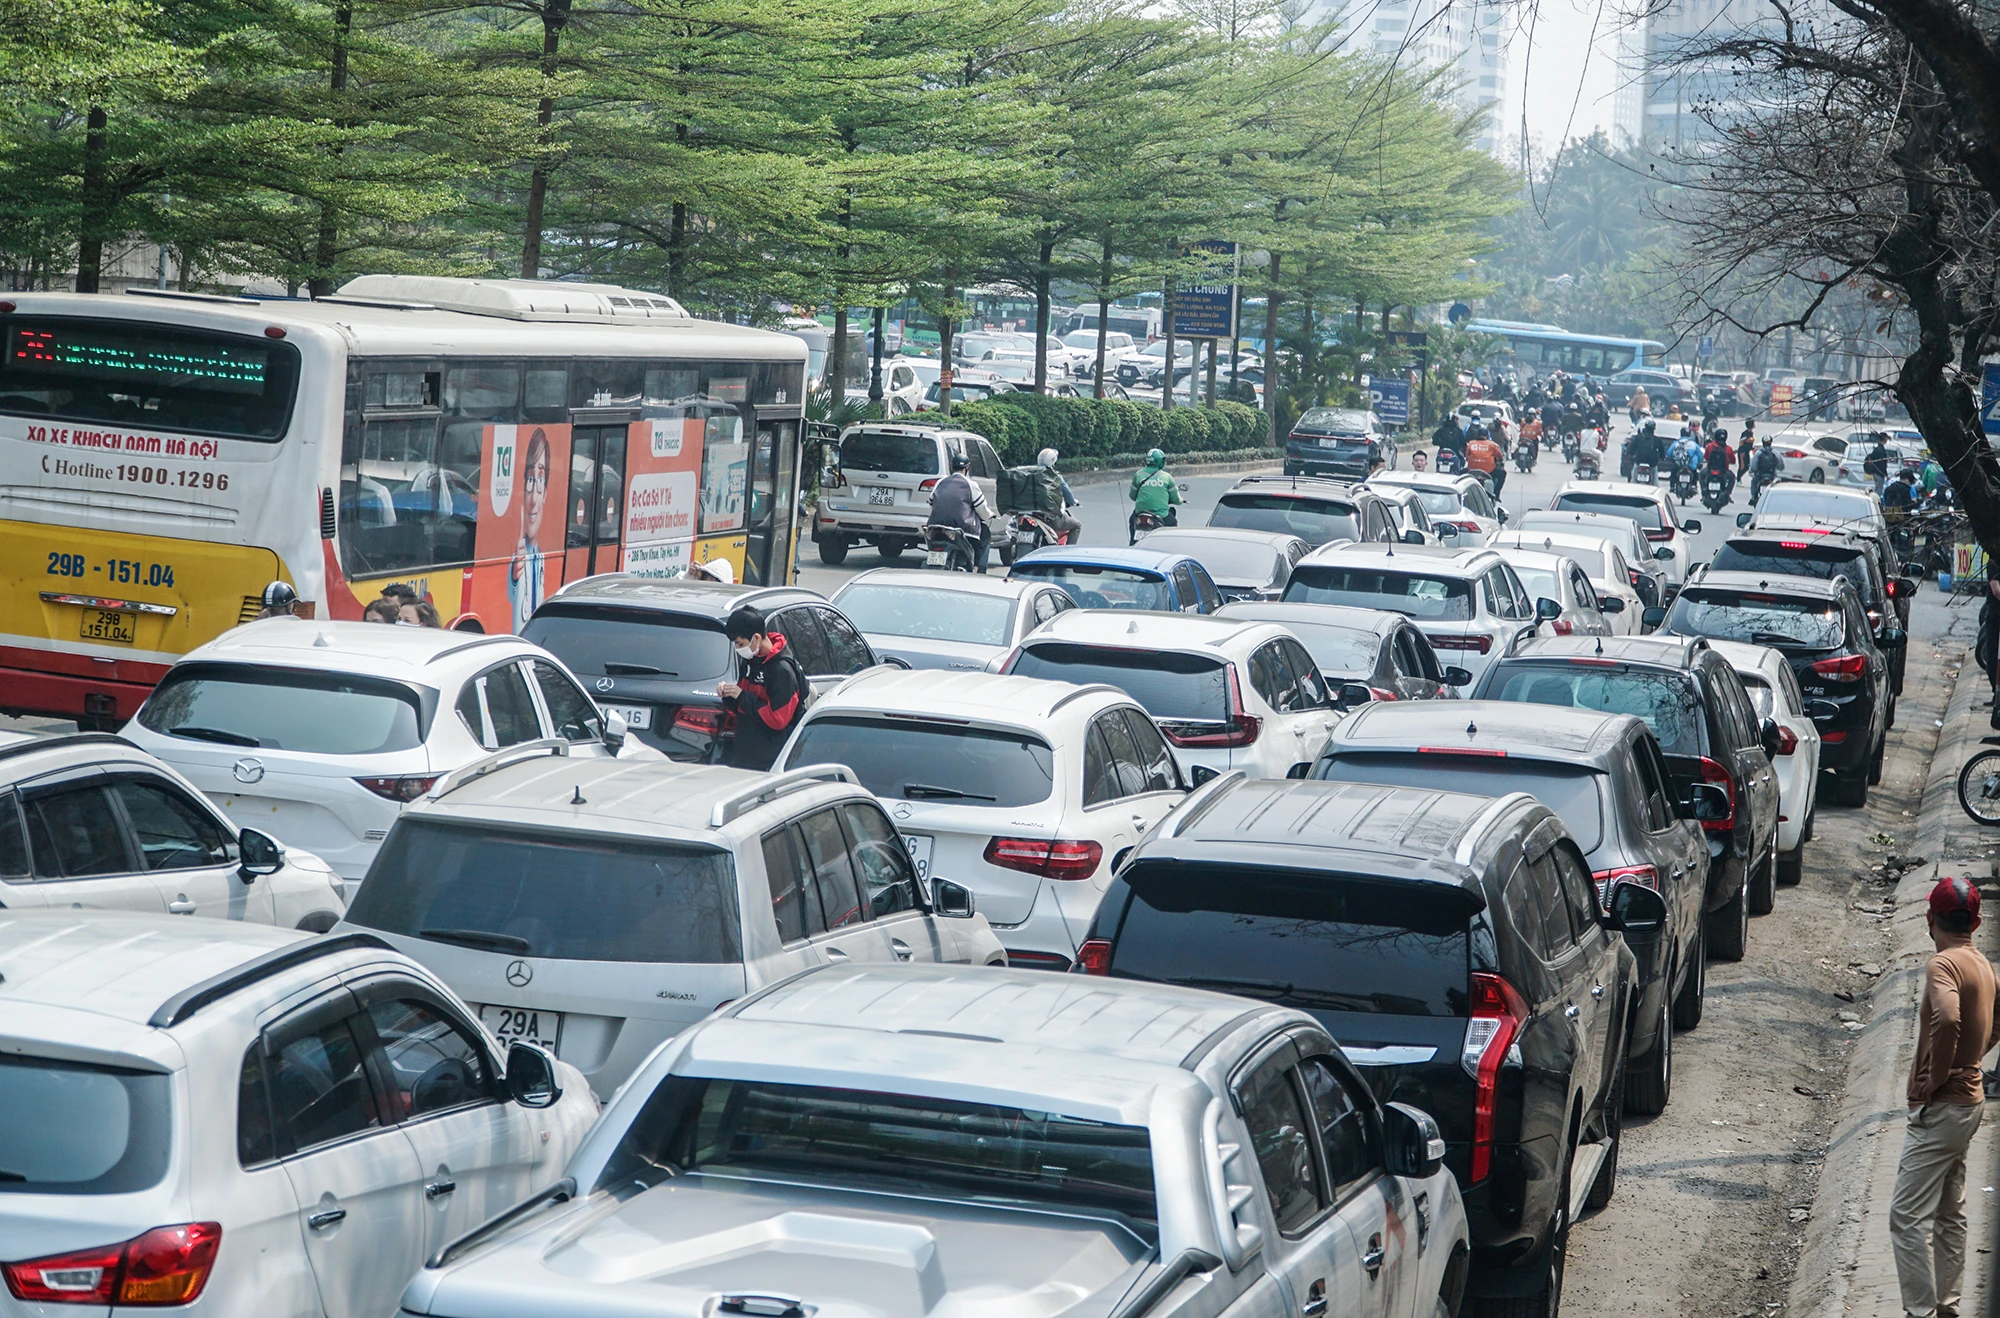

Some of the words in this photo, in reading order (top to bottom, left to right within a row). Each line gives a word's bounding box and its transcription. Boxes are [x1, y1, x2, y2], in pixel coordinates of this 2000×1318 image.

[51, 428, 68, 444] XE
[72, 430, 122, 449] KHÁCH
[125, 435, 161, 453] NAM
[165, 438, 186, 457] HÀ
[189, 440, 219, 460] NỘI
[55, 459, 113, 480] Hotline
[117, 464, 229, 491] 1900.1296
[47, 552, 85, 578] 29B
[107, 559, 174, 588] 151.04
[88, 624, 128, 639] 151.04
[97, 612, 121, 626] 29B
[497, 1010, 539, 1039] 29A
